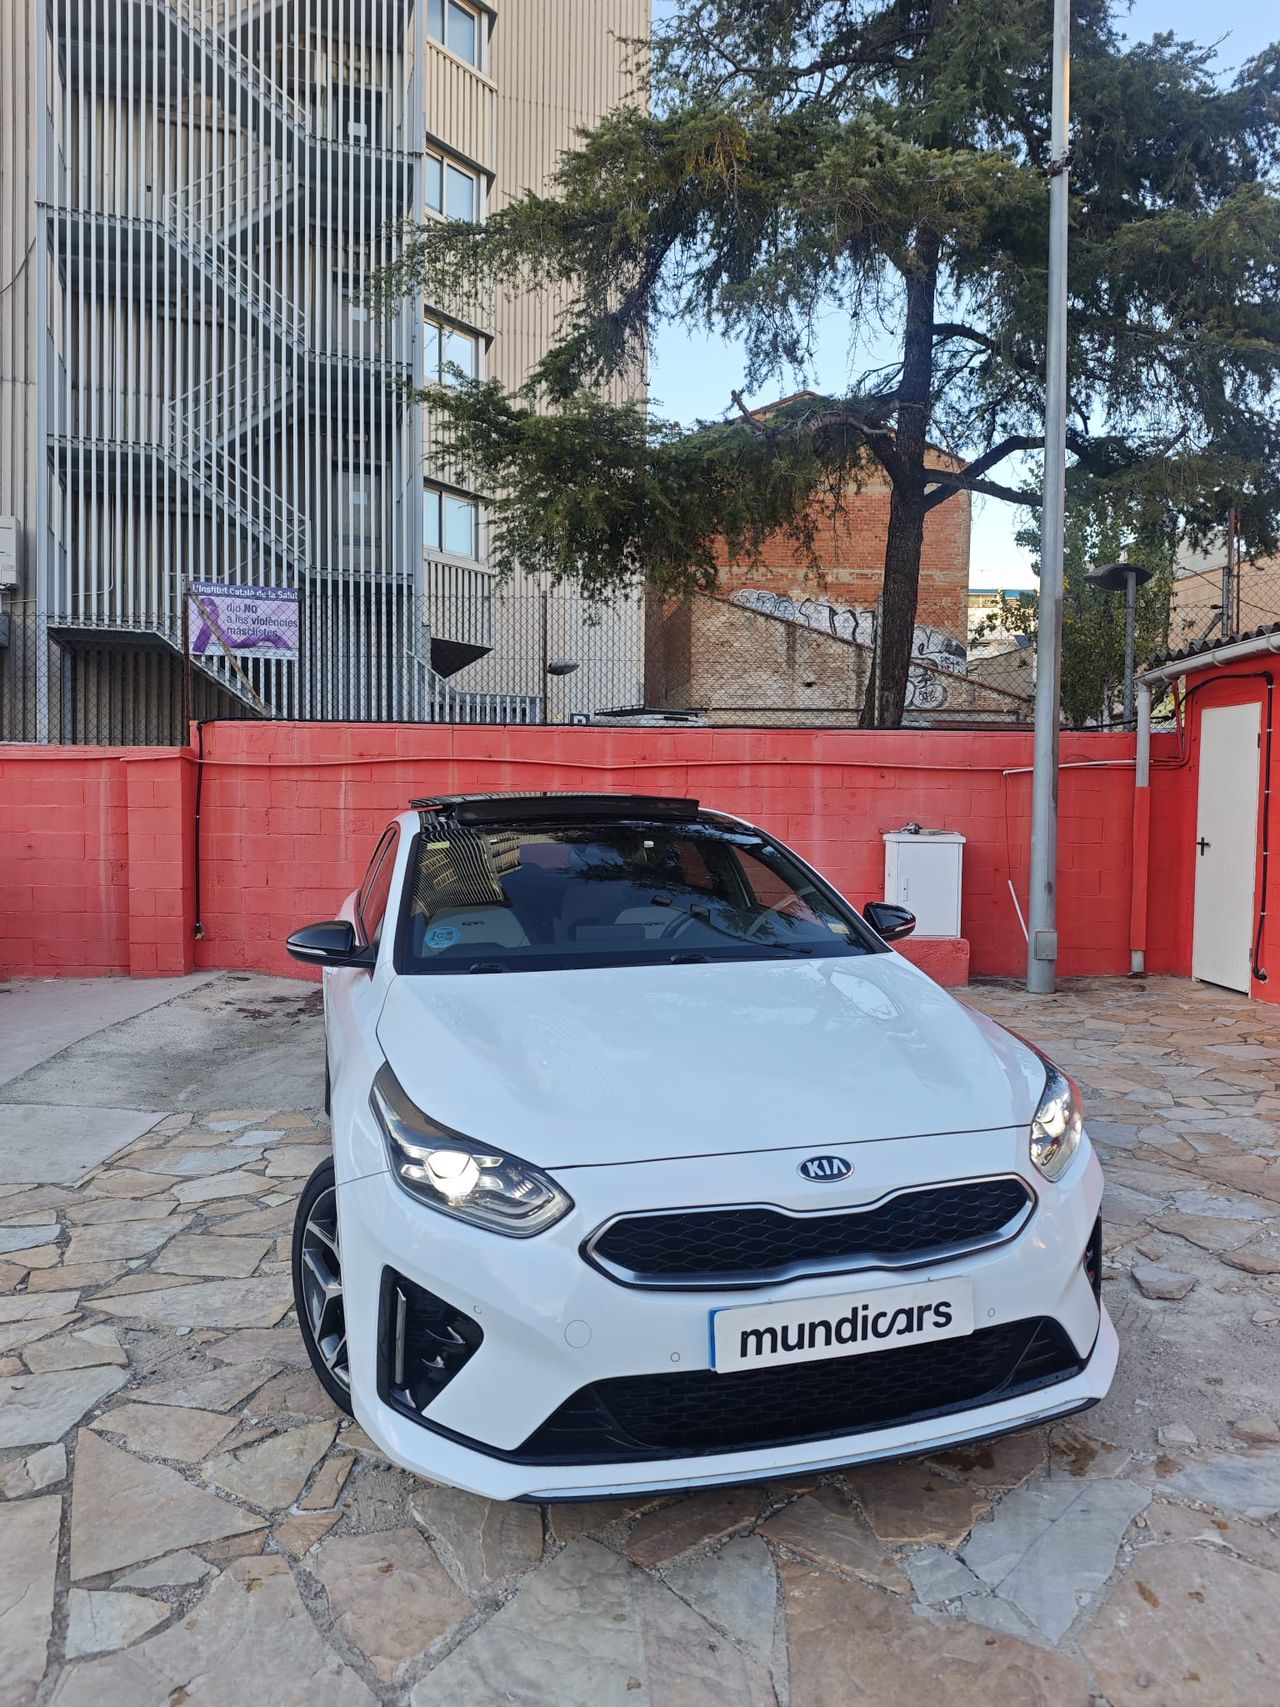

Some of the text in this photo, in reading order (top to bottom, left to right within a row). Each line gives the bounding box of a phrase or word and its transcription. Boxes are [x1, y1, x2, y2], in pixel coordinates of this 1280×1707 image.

[192, 583, 229, 595] L'Institut
[229, 588, 255, 597] Català
[226, 603, 258, 613] diu NO
[235, 615, 249, 625] les
[226, 627, 278, 637] masclistes
[805, 1158, 848, 1177] KIA
[739, 1301, 953, 1358] mundicars
